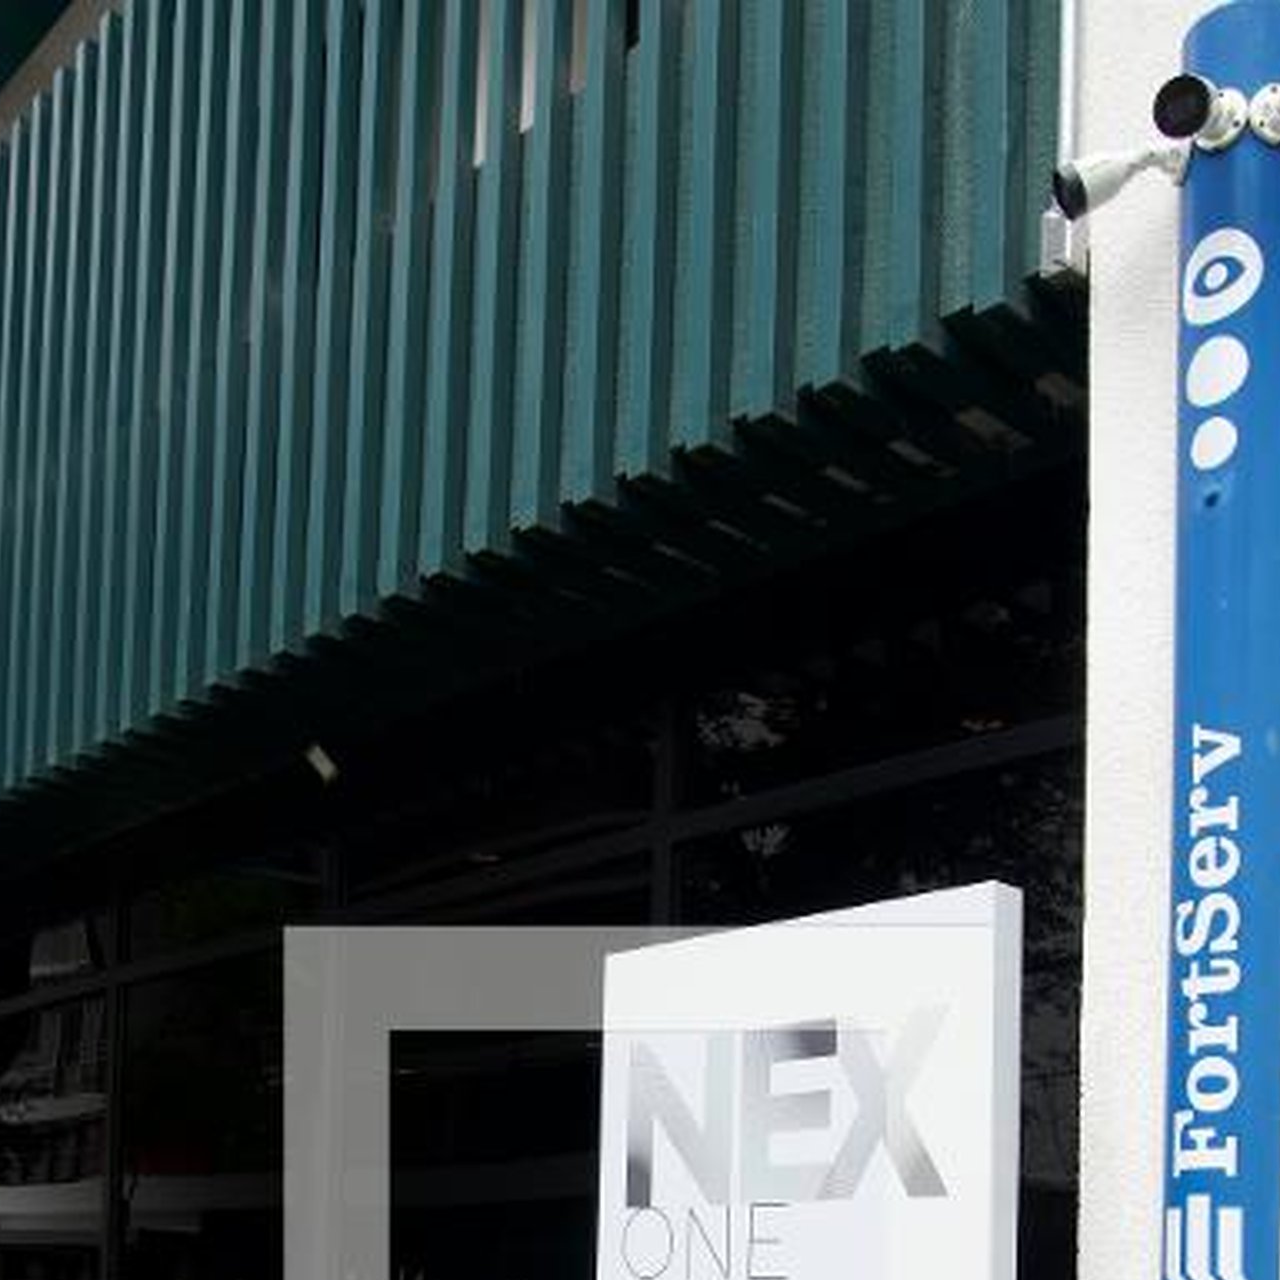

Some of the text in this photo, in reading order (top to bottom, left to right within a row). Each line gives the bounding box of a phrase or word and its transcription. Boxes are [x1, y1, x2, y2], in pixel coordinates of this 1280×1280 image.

[1173, 723, 1243, 1179] FortServ
[625, 1001, 950, 1209] NEX
[621, 1201, 790, 1280] ONE
